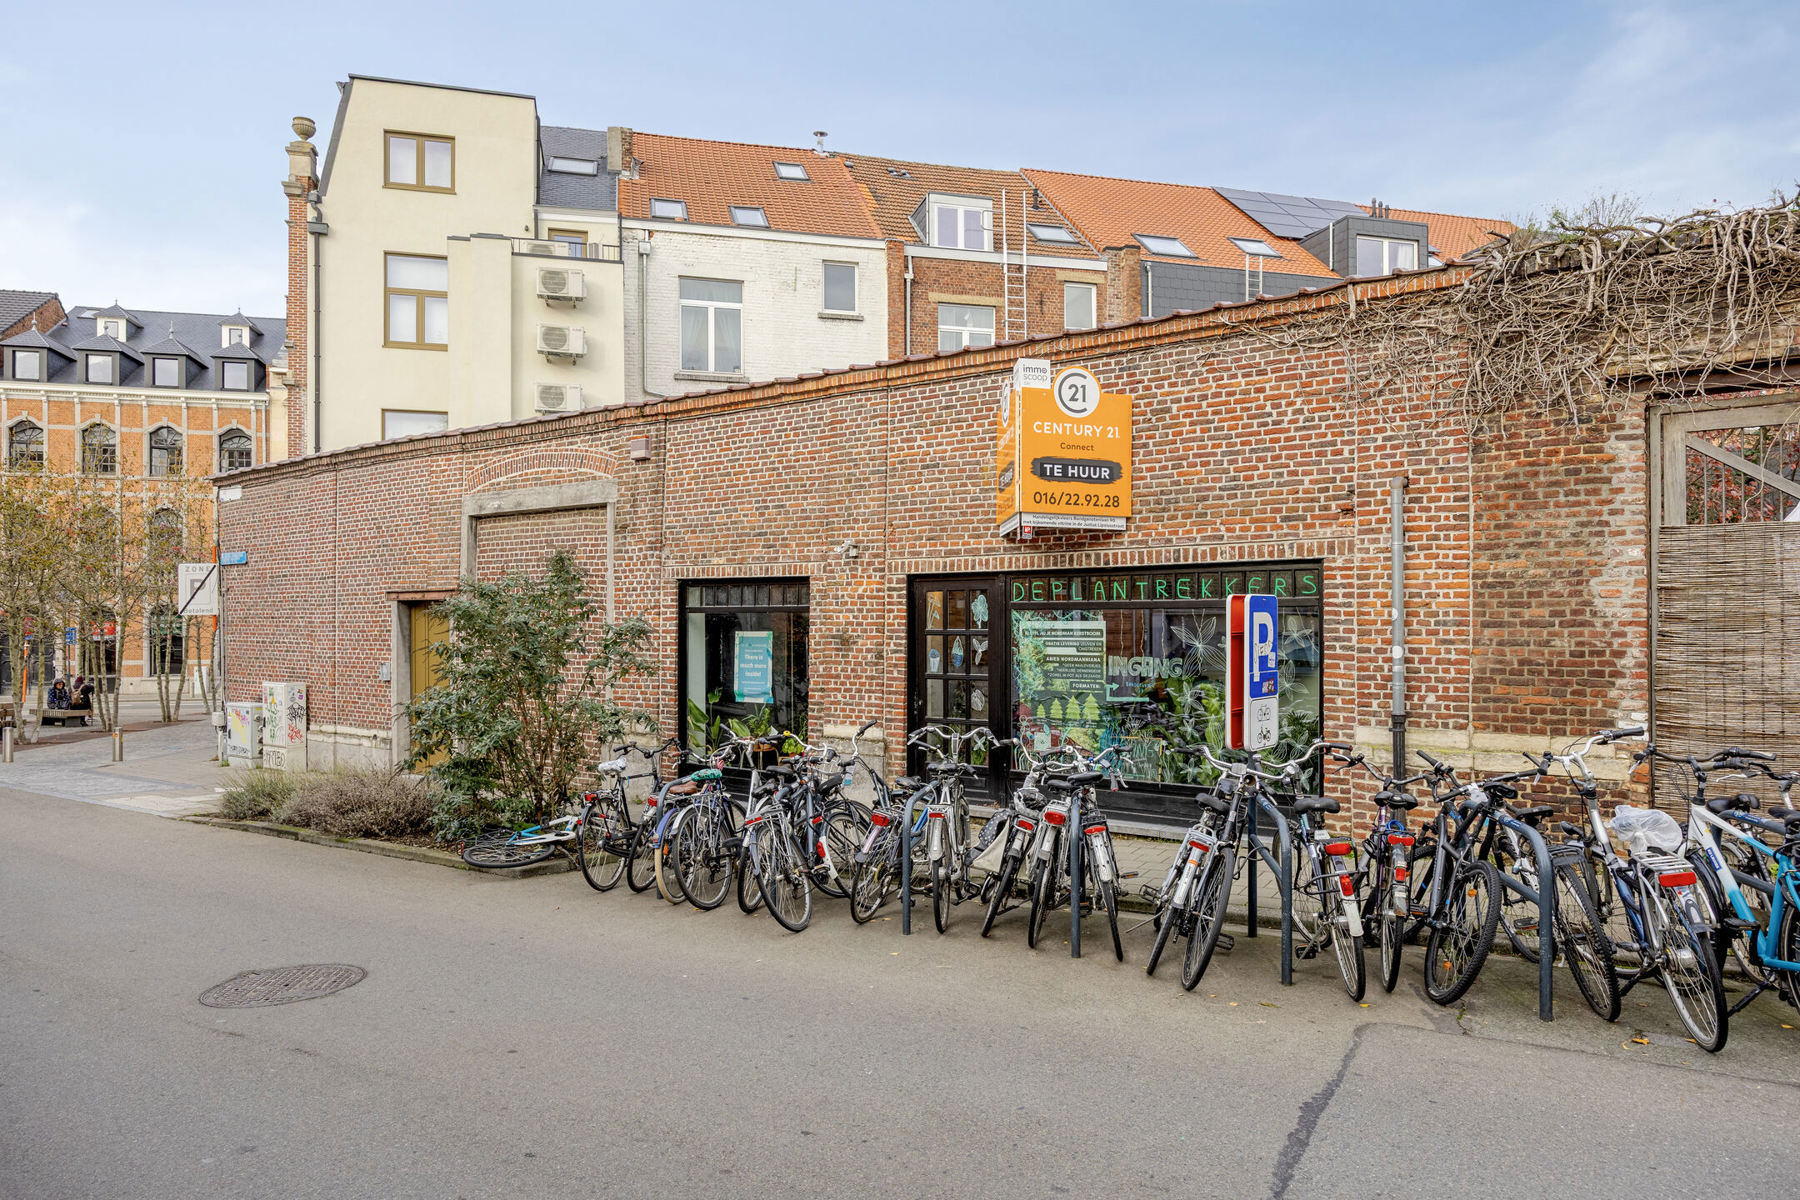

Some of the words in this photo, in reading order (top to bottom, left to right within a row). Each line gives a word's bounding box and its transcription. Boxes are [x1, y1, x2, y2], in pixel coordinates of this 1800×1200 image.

[1023, 364, 1048, 374] immo
[1023, 373, 1048, 382] scoop
[1068, 383, 1087, 403] 21
[1033, 421, 1103, 437] CENTURY
[1106, 426, 1120, 439] 21
[1060, 442, 1095, 451] Connect
[1044, 464, 1063, 477] TE
[1068, 465, 1110, 479] HUUR
[1033, 491, 1120, 508] 016/22.92.28
[1108, 655, 1183, 679] INGANG
